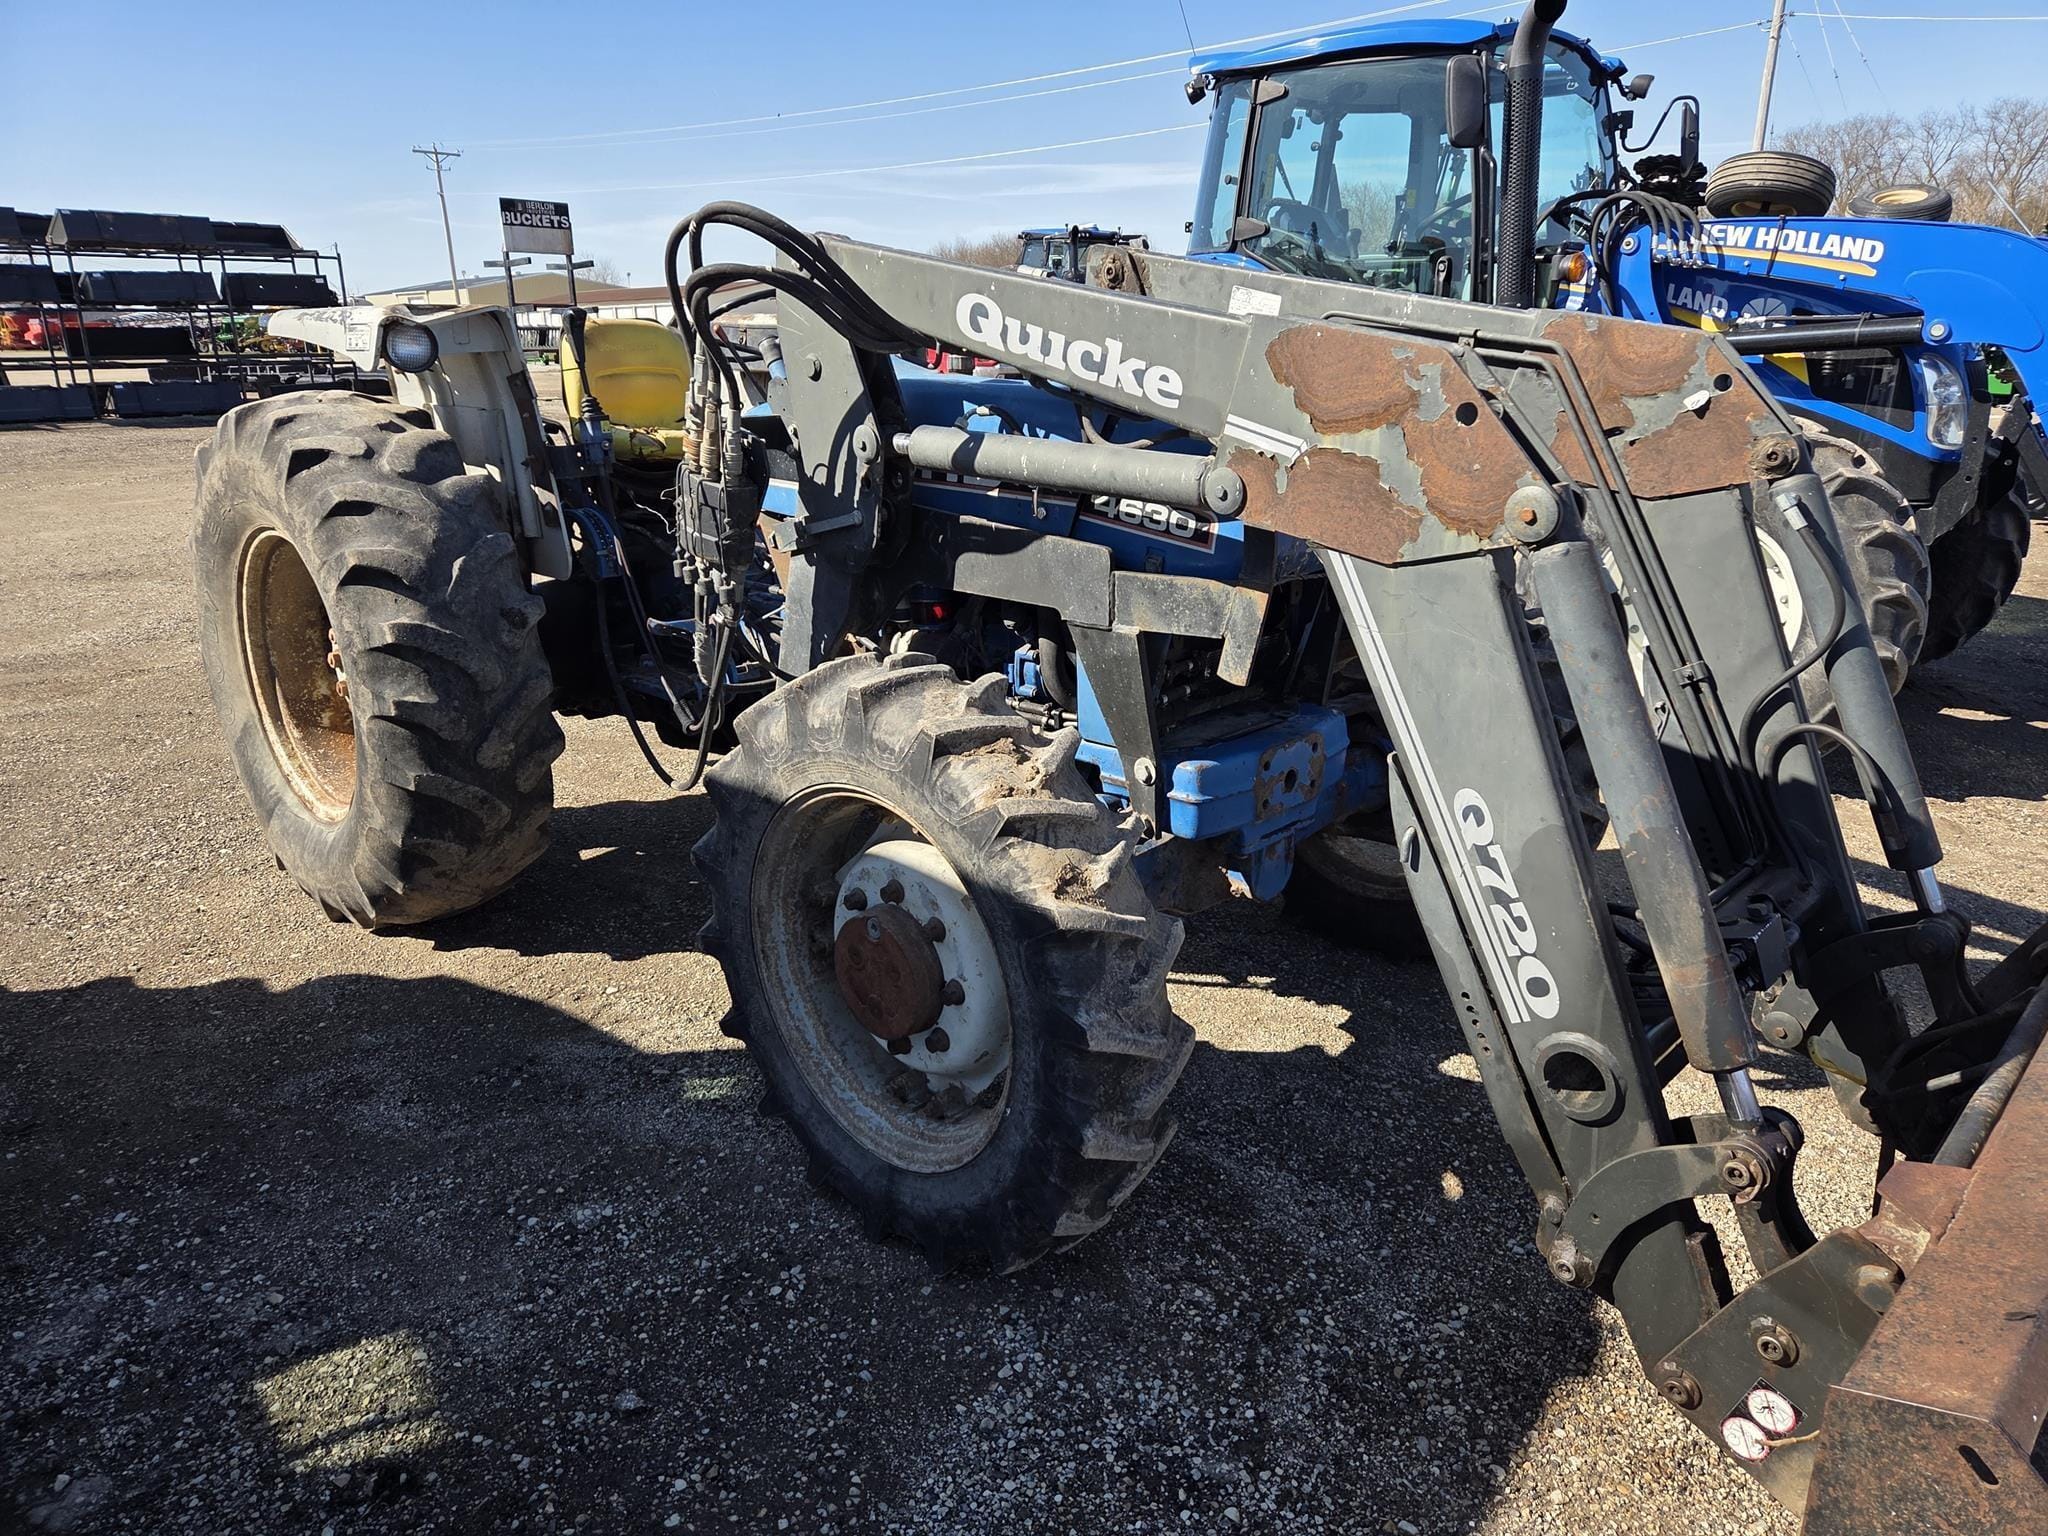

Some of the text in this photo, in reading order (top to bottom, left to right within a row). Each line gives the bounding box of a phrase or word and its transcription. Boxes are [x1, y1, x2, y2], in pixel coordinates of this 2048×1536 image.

[502, 211, 569, 228] BUCKETS
[525, 201, 555, 210] BERLON
[1755, 226, 1885, 263] HOLLAND
[956, 293, 1183, 409] Quicke
[1091, 495, 1197, 538] 4630
[1454, 788, 1560, 1019] Q720
